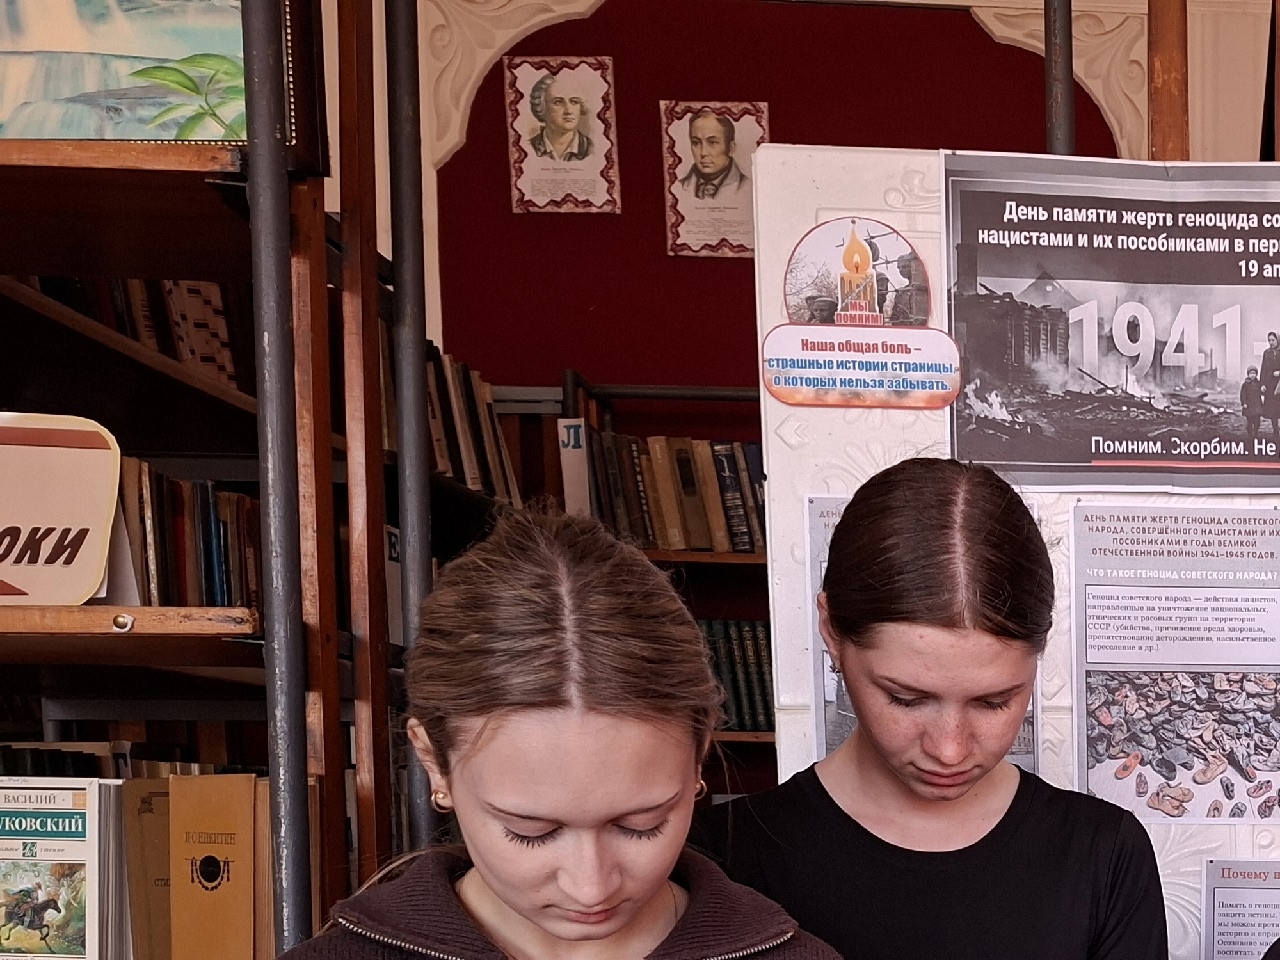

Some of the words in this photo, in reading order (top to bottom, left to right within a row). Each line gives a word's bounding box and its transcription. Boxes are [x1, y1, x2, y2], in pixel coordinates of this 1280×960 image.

[1004, 201, 1049, 223] День
[1052, 207, 1116, 224] памяти
[1121, 210, 1173, 228] жертв
[1178, 211, 1258, 232] геноцида
[978, 228, 1073, 250] нацистами
[1077, 234, 1088, 249] и
[1093, 234, 1113, 249] их
[1117, 231, 1229, 253] пособниками
[1234, 239, 1245, 252] в
[1238, 261, 1259, 278] 19
[849, 301, 868, 311] МЫ
[836, 313, 883, 325] ПОМНИМ!
[1068, 301, 1241, 379] 1941
[801, 338, 834, 354] Наша
[837, 339, 879, 356] общая
[881, 340, 910, 356] боль
[767, 358, 834, 375] страшные
[836, 358, 888, 374] истории
[891, 361, 958, 376] страницы,
[773, 376, 782, 389] о
[784, 376, 837, 392] которых
[840, 376, 884, 390] нельзя
[887, 376, 951, 392] забывать.
[1092, 436, 1167, 455] Помним.
[1172, 438, 1249, 458] Скорбим.
[1254, 440, 1277, 456] Не
[1084, 514, 1106, 523] ДЕНЬ
[1110, 515, 1147, 523] ПАМЯТИ
[1150, 516, 1179, 524] ЖЕРТВ
[1182, 516, 1229, 526] ГЕНОЦИДА
[1131, 526, 1198, 535] СОВЕРШЁННОГО
[1201, 528, 1257, 537] НАЦИСТАМИ
[1269, 529, 1280, 537] ИХ
[1112, 537, 1180, 546] ПОСОБНИКАМИ
[1191, 539, 1214, 547] ГОДЫ
[1218, 539, 1257, 547] ВЕЛИКОЙ
[1092, 547, 1164, 557] ОТЕЧЕСТВЕННОЙ
[1167, 548, 1198, 558] ВОЙНЫ
[1247, 551, 1278, 559] ГОДОВ.
[1087, 569, 1104, 577] ЧТО
[1107, 569, 1135, 578] ТАКОЕ
[1137, 570, 1179, 579] ГЕНОЦИД
[1181, 571, 1233, 579] СОВЕТСКОГО
[1236, 572, 1277, 580] НАРОДА?
[1088, 623, 1111, 631] СССР
[4, 793, 56, 804] ВАСИЛИЙ
[1220, 867, 1269, 882] Почему
